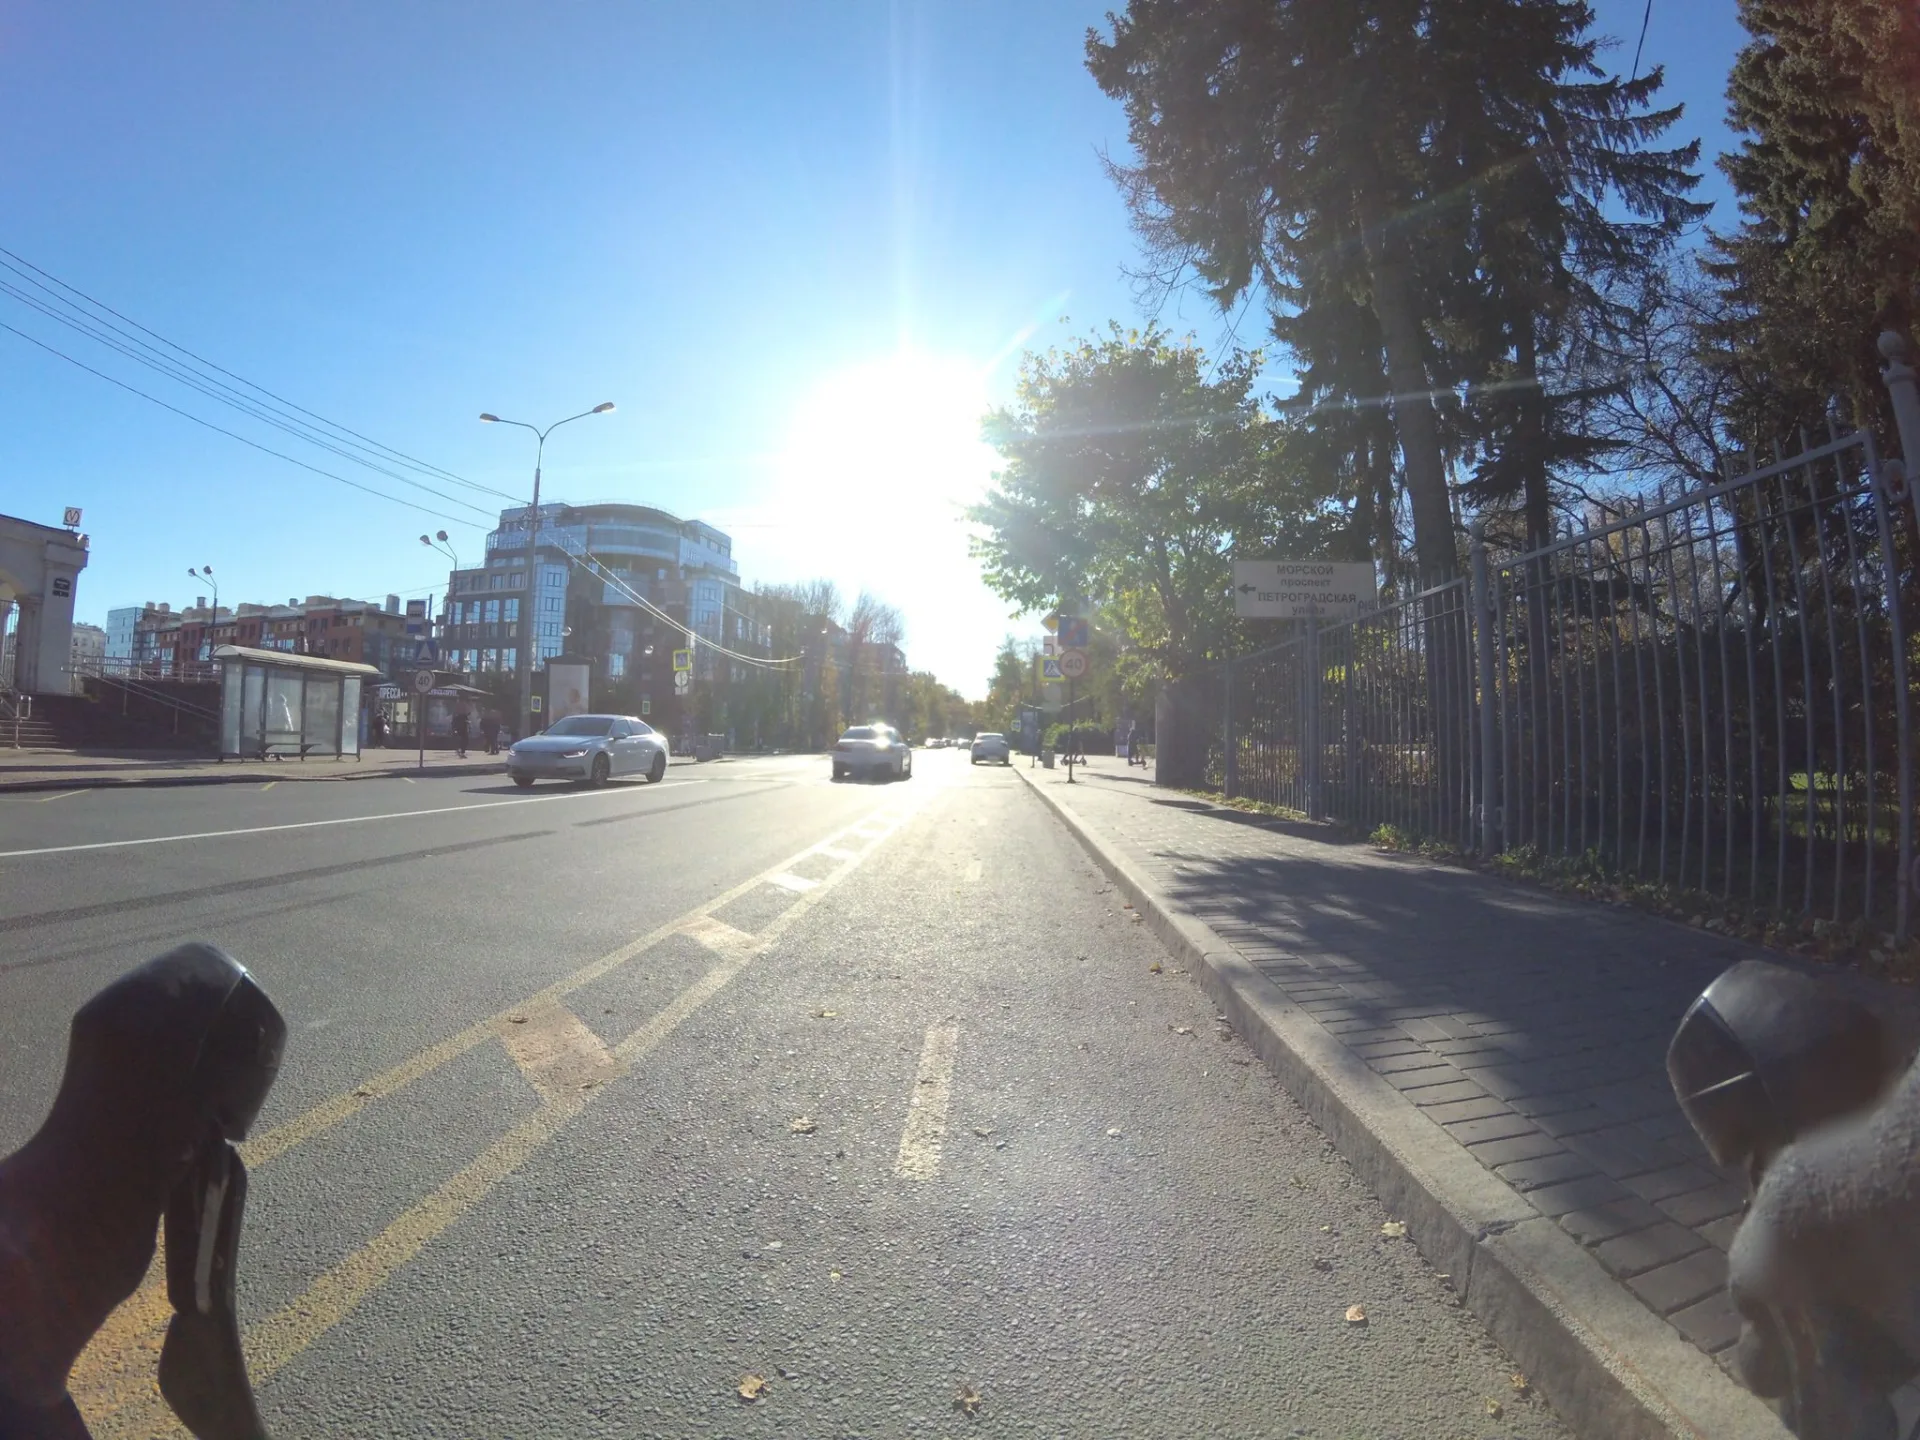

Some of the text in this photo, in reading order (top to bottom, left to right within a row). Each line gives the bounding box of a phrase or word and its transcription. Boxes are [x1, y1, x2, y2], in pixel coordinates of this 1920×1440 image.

[1276, 564, 1334, 575] МОРСКОЙ
[1280, 578, 1331, 588] проспект
[1257, 591, 1357, 604] ПЕТРОГРАДСКАЯ
[1291, 605, 1326, 616] ула
[1065, 658, 1082, 670] 40
[418, 675, 430, 686] 40
